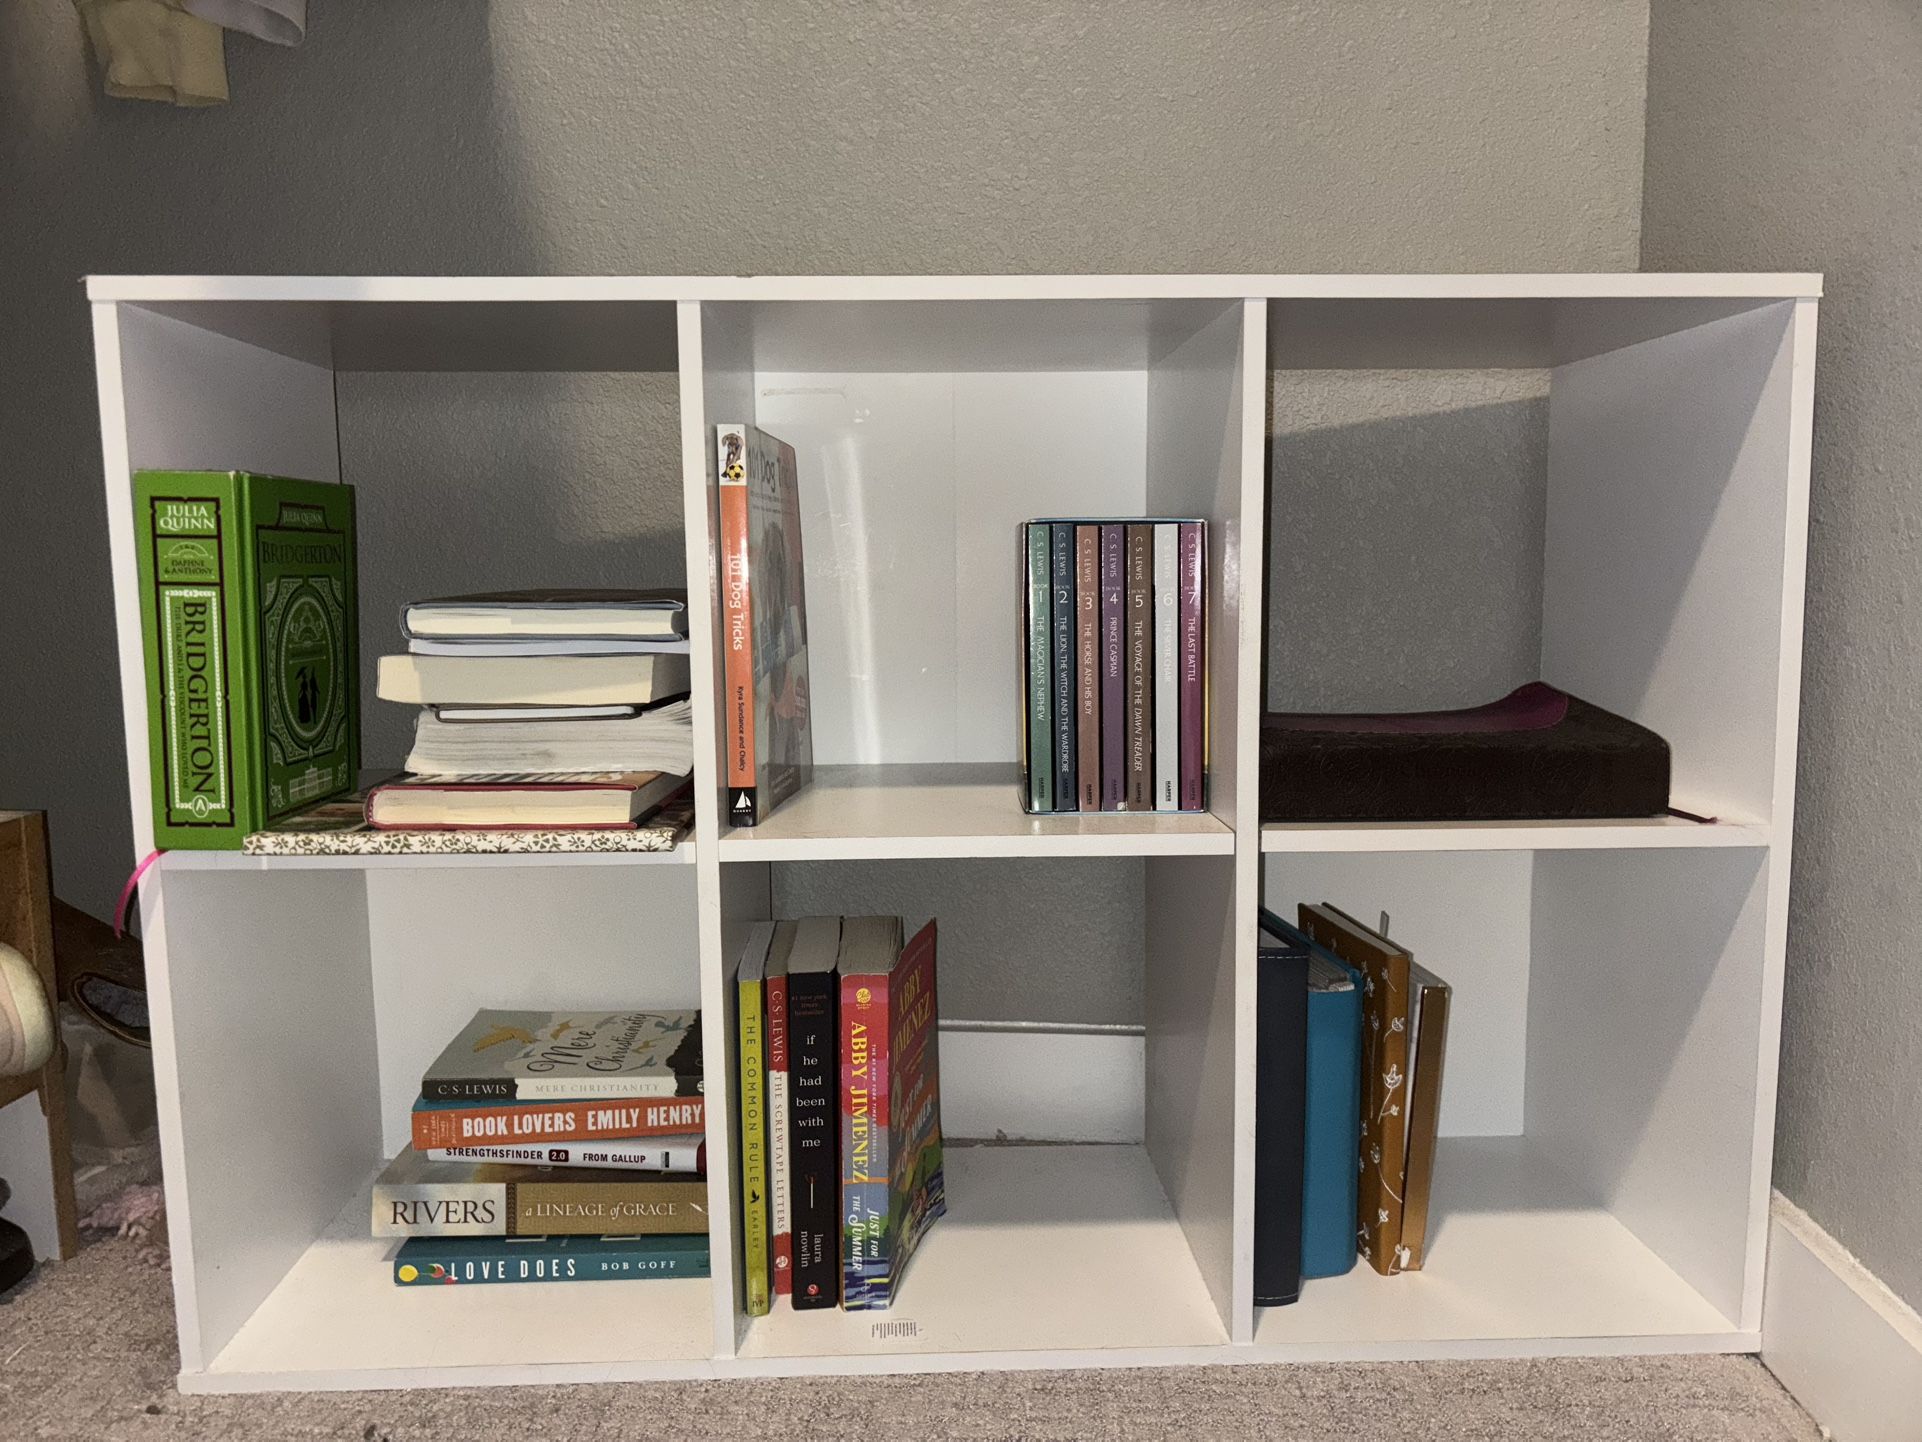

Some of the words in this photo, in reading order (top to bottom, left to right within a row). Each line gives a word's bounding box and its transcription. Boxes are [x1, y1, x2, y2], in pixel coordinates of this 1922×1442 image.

[167, 505, 208, 517] JULIA
[160, 517, 215, 531] QUINN
[262, 541, 342, 564] BRIDGERTON
[1059, 552, 1067, 576] LEWIS
[730, 553, 742, 576] 101
[1084, 558, 1092, 583] LEWIS
[1135, 556, 1143, 580] LEWIS
[1188, 553, 1196, 577] LEWIS
[729, 582, 742, 609] Dog
[1059, 591, 1068, 604] 2
[1085, 597, 1093, 610] 3
[1109, 592, 1118, 604] 4
[1135, 595, 1143, 608] 5
[1163, 593, 1173, 606] 6
[1188, 591, 1197, 604] 7
[732, 613, 745, 651] Tricks
[1037, 616, 1045, 632] THE
[1084, 622, 1092, 637] THE
[1110, 617, 1118, 642] PRINCE
[1134, 620, 1142, 636] THE
[1037, 638, 1045, 685] MAGICIAN'S
[1060, 655, 1068, 670] THE
[1084, 641, 1092, 665] HORSE
[1110, 645, 1118, 677] CASPIAN
[1134, 639, 1142, 672] VOYAGE
[1060, 671, 1068, 697] WITCH
[1084, 668, 1092, 685] AND
[1134, 675, 1142, 686] OF
[184, 602, 215, 794] BRIDGERTON
[1037, 687, 1045, 721] NEPHEW
[1084, 686, 1092, 699] HIS
[1134, 690, 1142, 705] THE
[1084, 701, 1093, 715] BOY
[1061, 717, 1069, 731] THE
[1134, 708, 1142, 734] DAWN
[1061, 733, 1069, 773] WARDROBE
[1134, 737, 1143, 772] TREADER
[746, 1015, 756, 1045] THE
[772, 1019, 783, 1062] LEWIS
[806, 1034, 816, 1045] if
[526, 1030, 597, 1073] Mere
[586, 1013, 667, 1072] Christianity
[851, 1021, 868, 1080] ABBY
[803, 1056, 818, 1066] he
[466, 1084, 507, 1094] LEWIS
[535, 1085, 567, 1093] MERE
[571, 1083, 660, 1092] CHRISTIANITY
[774, 1075, 783, 1098] THE
[799, 1075, 822, 1086] had
[747, 1056, 758, 1131] COMMON
[796, 1098, 826, 1107] been
[462, 1116, 508, 1137] BOOK
[513, 1112, 576, 1134] LOVERS
[587, 1107, 640, 1131] EMILY
[647, 1104, 702, 1127] HENRY
[798, 1116, 824, 1127] with
[775, 1104, 784, 1174] SCREWTAPE
[802, 1139, 821, 1147] me
[850, 1086, 869, 1183] JIMENEZ
[446, 1147, 543, 1160] STRENGTHSFINDER
[551, 1151, 566, 1160] 2.0
[583, 1152, 608, 1162] FROM
[611, 1154, 646, 1164] GALLUP
[748, 1142, 759, 1183] RULE
[390, 1200, 495, 1225] RIVERS
[525, 1207, 532, 1216] a
[537, 1204, 607, 1216] LINEAGE
[610, 1202, 624, 1220] of
[623, 1203, 677, 1216] GRACE
[776, 1180, 785, 1229] LETTERS
[852, 1196, 861, 1212] THE
[751, 1210, 759, 1248] EARLEY
[867, 1208, 880, 1238] JUST
[800, 1231, 810, 1268] nowlin
[814, 1234, 824, 1263] laura
[848, 1214, 866, 1271] SUMMER
[870, 1240, 879, 1257] FOR
[451, 1261, 505, 1280] LOVE
[519, 1259, 576, 1278] DOES
[601, 1262, 630, 1271] BOB
[638, 1261, 677, 1269] GOFF
